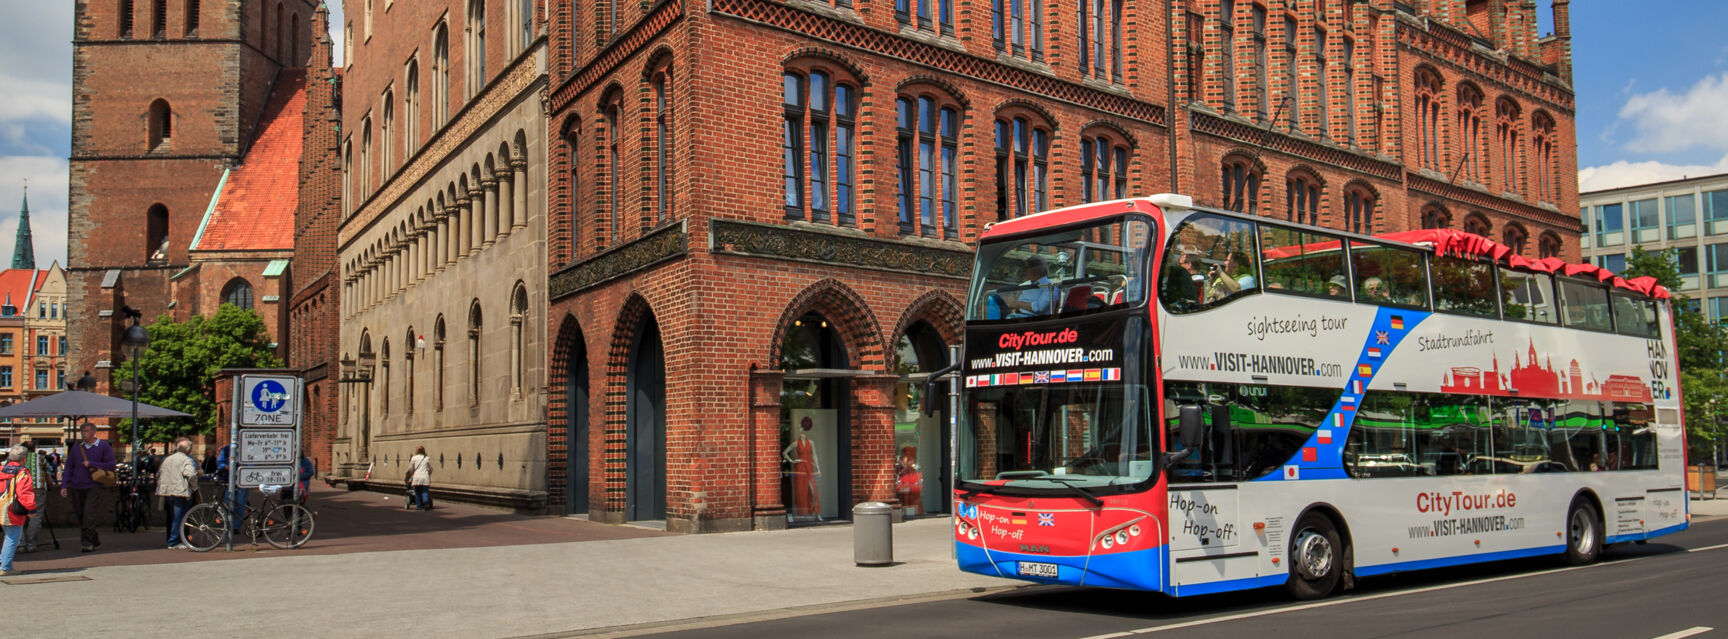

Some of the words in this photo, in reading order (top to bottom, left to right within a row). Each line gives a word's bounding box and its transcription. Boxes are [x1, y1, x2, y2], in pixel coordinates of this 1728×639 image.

[1247, 314, 1317, 341] sightseeing
[1321, 315, 1348, 331] tour
[998, 328, 1078, 350] CityTour.de
[1418, 329, 1494, 352] Stadtrundfahrt
[971, 348, 1113, 370] www.VISIT-HANNOVER.com
[1178, 351, 1342, 377] www.VISIT-HANNOVER.com
[255, 413, 282, 423] ZONE
[1169, 494, 1218, 517] Hop-on
[1416, 489, 1517, 516] CityTour.de
[980, 510, 1010, 525] Hop-on
[1408, 515, 1525, 539] www.VISIT-HANNOVER.com
[991, 525, 1025, 541] Hop-off
[1183, 519, 1234, 542] Hop-off
[1019, 544, 1050, 554] MAN
[1039, 564, 1057, 575] 3001
